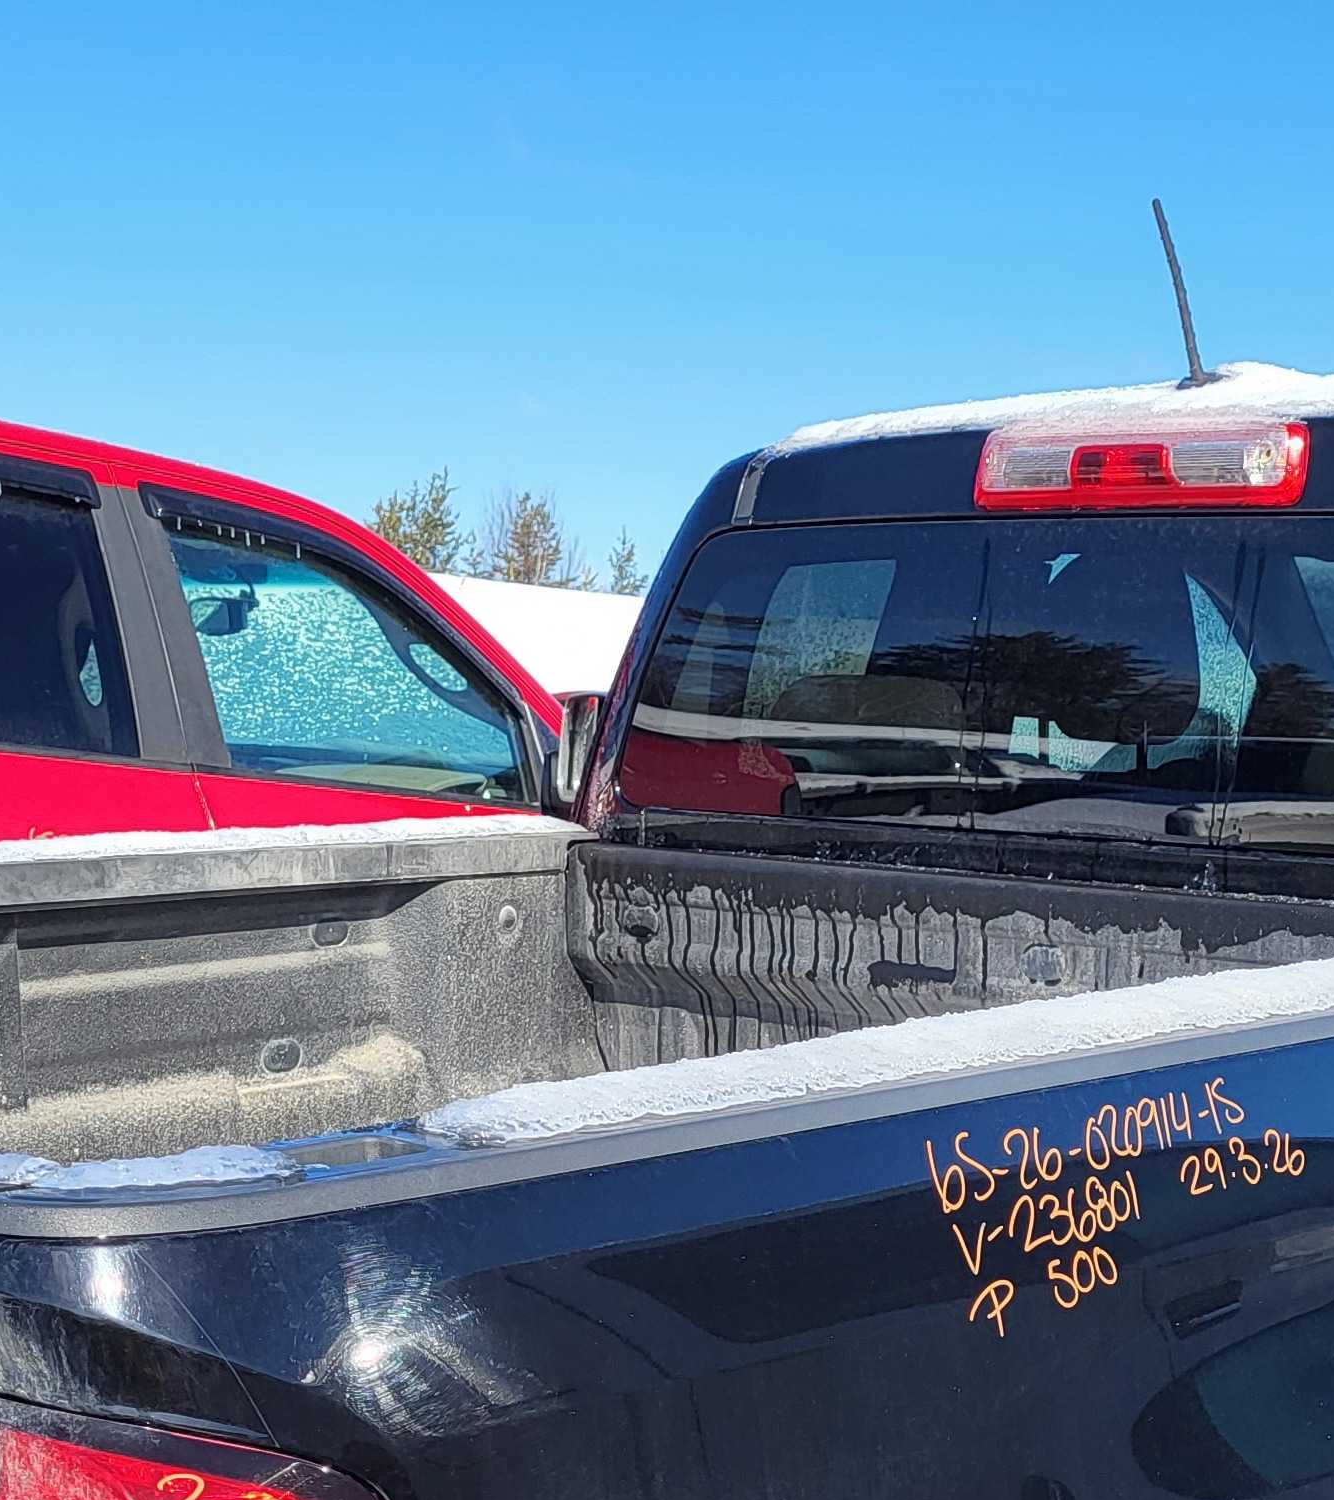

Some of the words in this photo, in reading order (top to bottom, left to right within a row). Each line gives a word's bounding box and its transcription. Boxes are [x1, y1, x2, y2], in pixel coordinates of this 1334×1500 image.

[951, 1170, 1141, 1276] V-236801
[1179, 1128, 1306, 1197] 29.3.26
[968, 1279, 1016, 1338] P
[1047, 1246, 1118, 1309] 500
